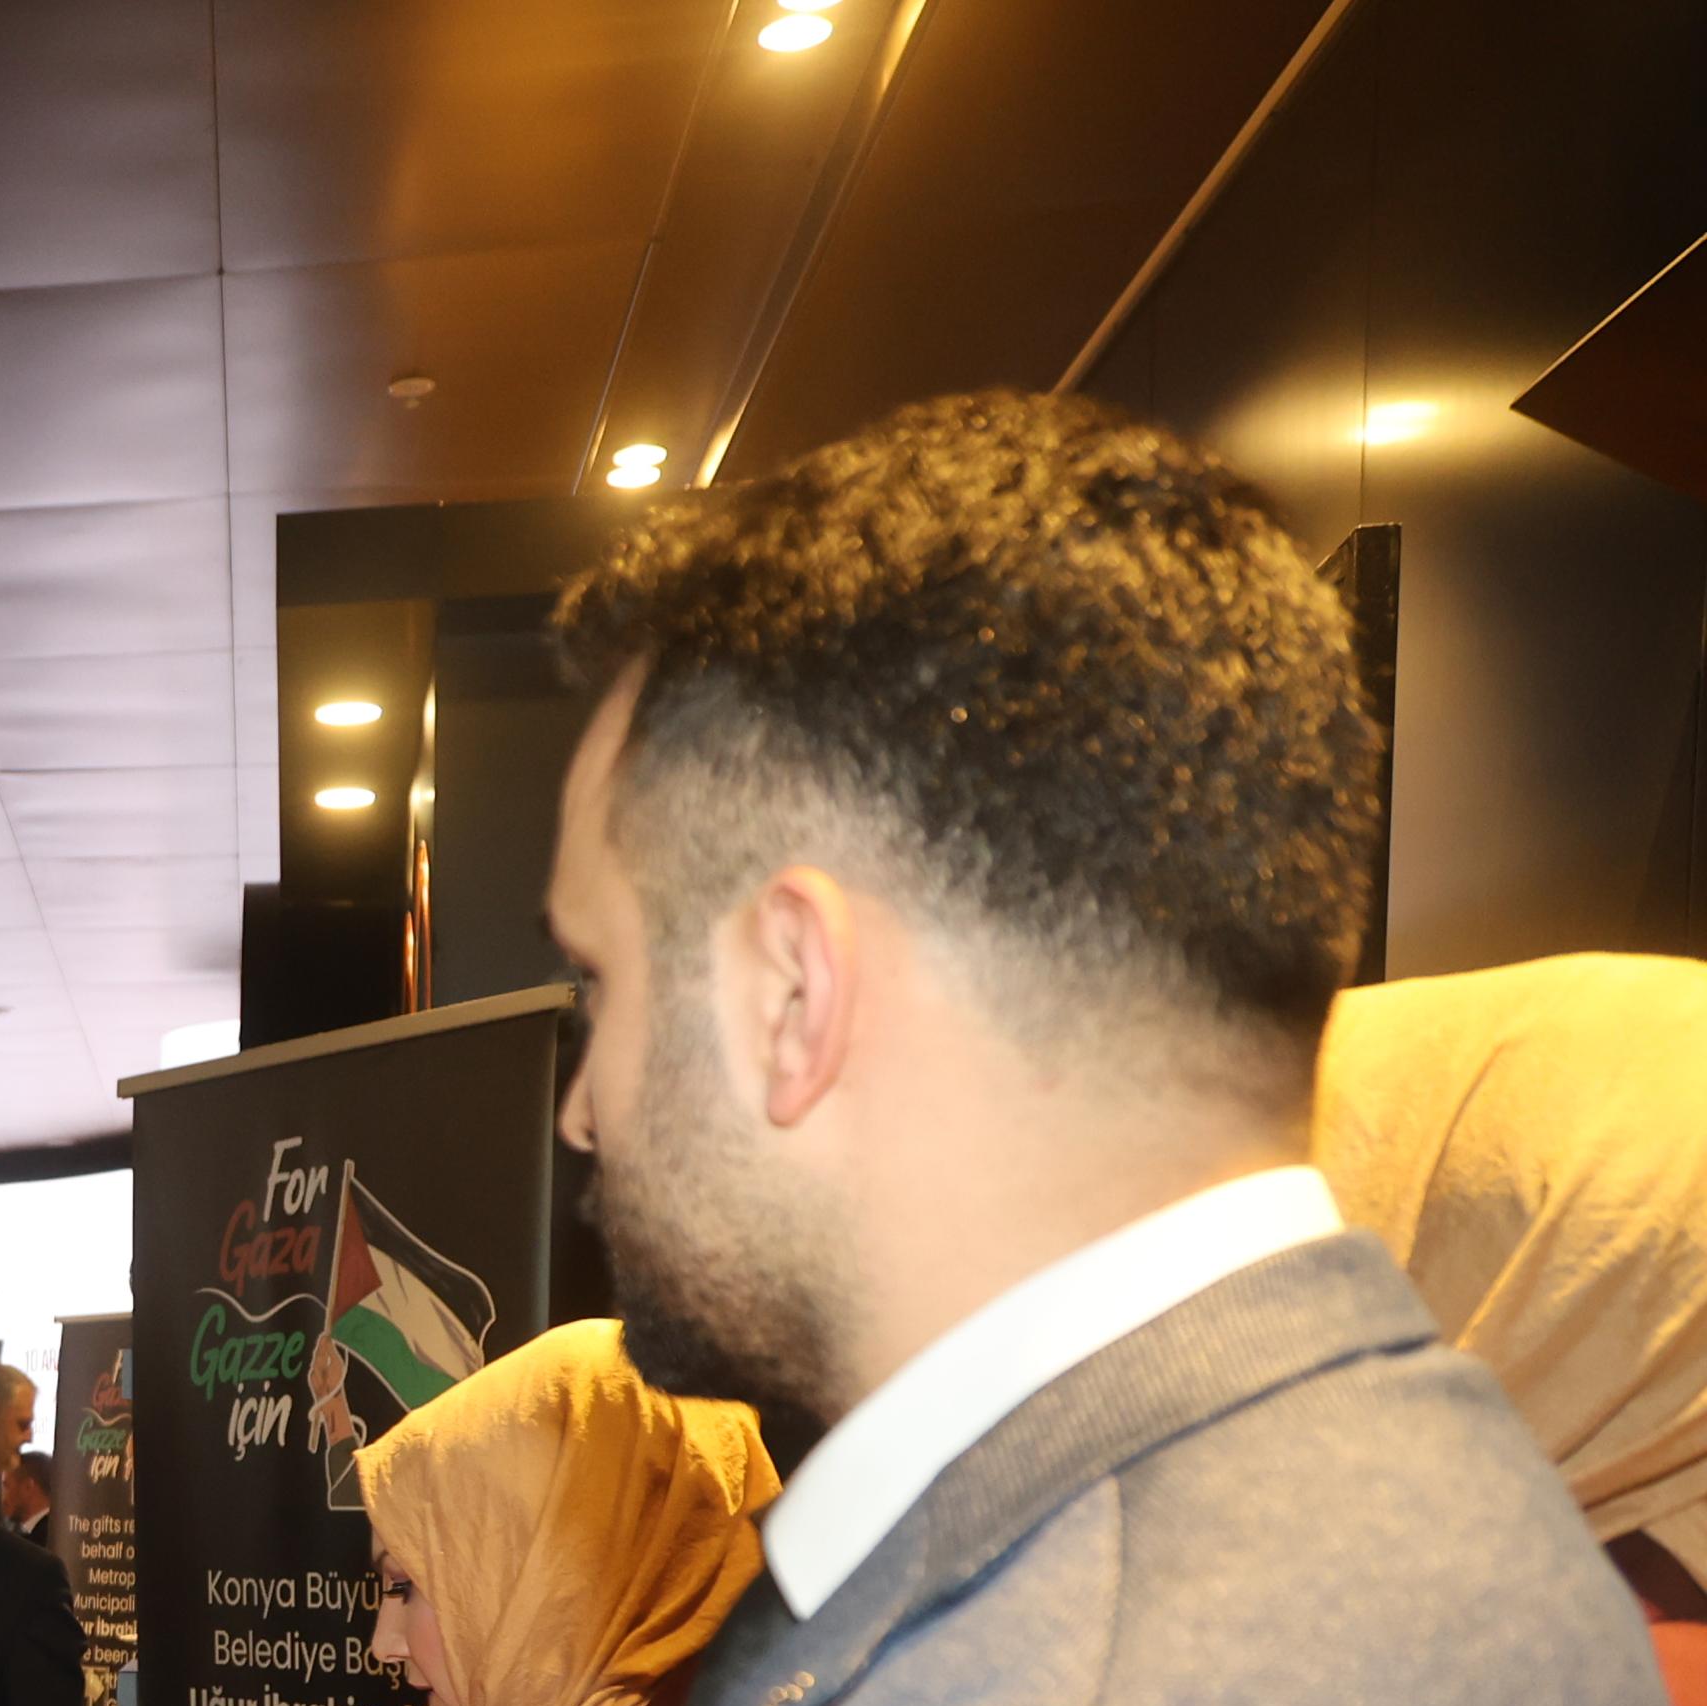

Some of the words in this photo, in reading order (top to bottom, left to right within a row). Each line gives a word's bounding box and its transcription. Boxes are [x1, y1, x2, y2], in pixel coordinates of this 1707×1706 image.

[263, 1136, 329, 1222] For
[219, 1200, 322, 1297] Gaza
[190, 1303, 306, 1401] Gazze
[77, 1416, 126, 1456] Gazze
[228, 1381, 292, 1461] için
[90, 1449, 120, 1484] için
[68, 1515, 88, 1533] The
[92, 1515, 121, 1538] gifts
[81, 1541, 124, 1559] behalf
[89, 1567, 136, 1590] Metrop
[207, 1570, 296, 1619] Konya
[94, 1645, 129, 1663] been
[214, 1630, 336, 1683] Belediye
[345, 1636, 409, 1690] Baş
